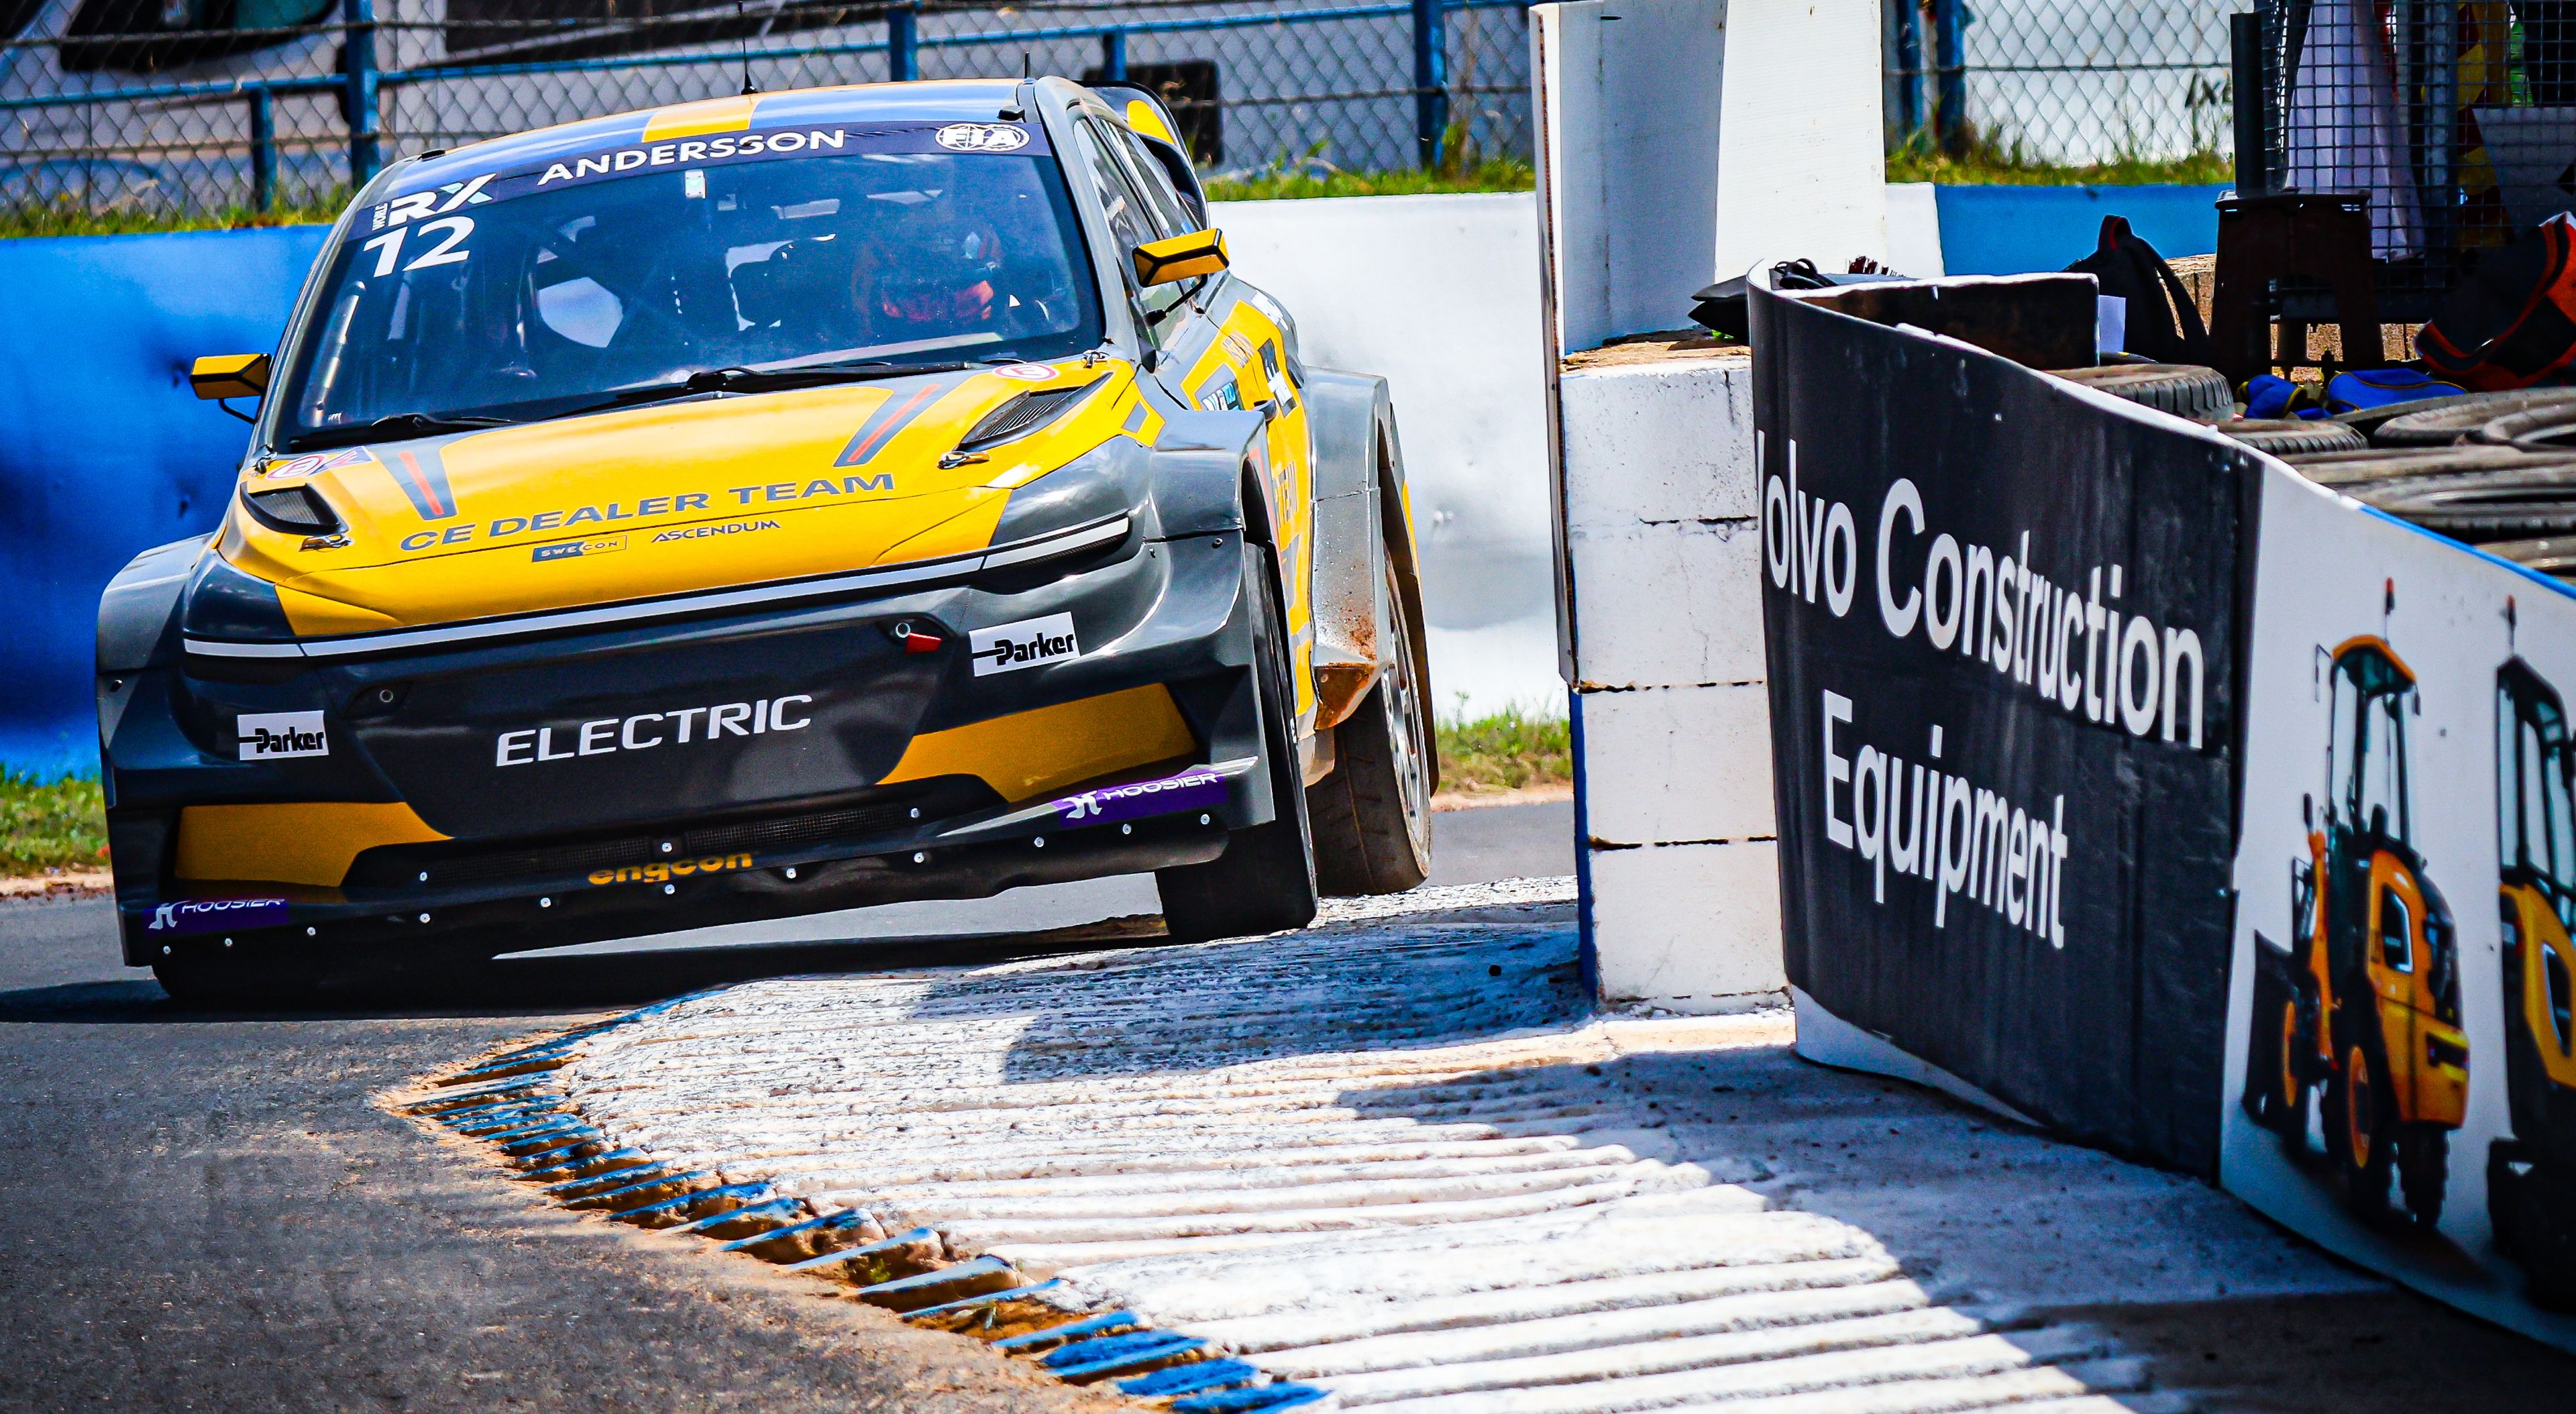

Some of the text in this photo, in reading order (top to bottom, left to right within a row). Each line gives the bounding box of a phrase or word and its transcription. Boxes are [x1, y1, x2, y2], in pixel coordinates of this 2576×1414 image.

[941, 127, 1022, 147] FIA
[537, 129, 845, 186] ANDERSSON
[388, 173, 496, 227] RX
[372, 203, 388, 231] WORLD
[363, 216, 475, 278] 12
[400, 474, 894, 551] CE DEALER TEAM
[651, 520, 781, 543] ASCENDUM
[541, 541, 619, 557] SWECON
[1877, 478, 2204, 749] Construction
[994, 632, 1074, 666] Parker
[254, 726, 325, 753] Parker
[496, 694, 812, 766] ELECTRIC
[1101, 772, 1218, 800] HOOSIER
[1822, 689, 2068, 949] Equipment
[588, 852, 753, 885] engcon
[181, 899, 285, 913] HOOSIER
